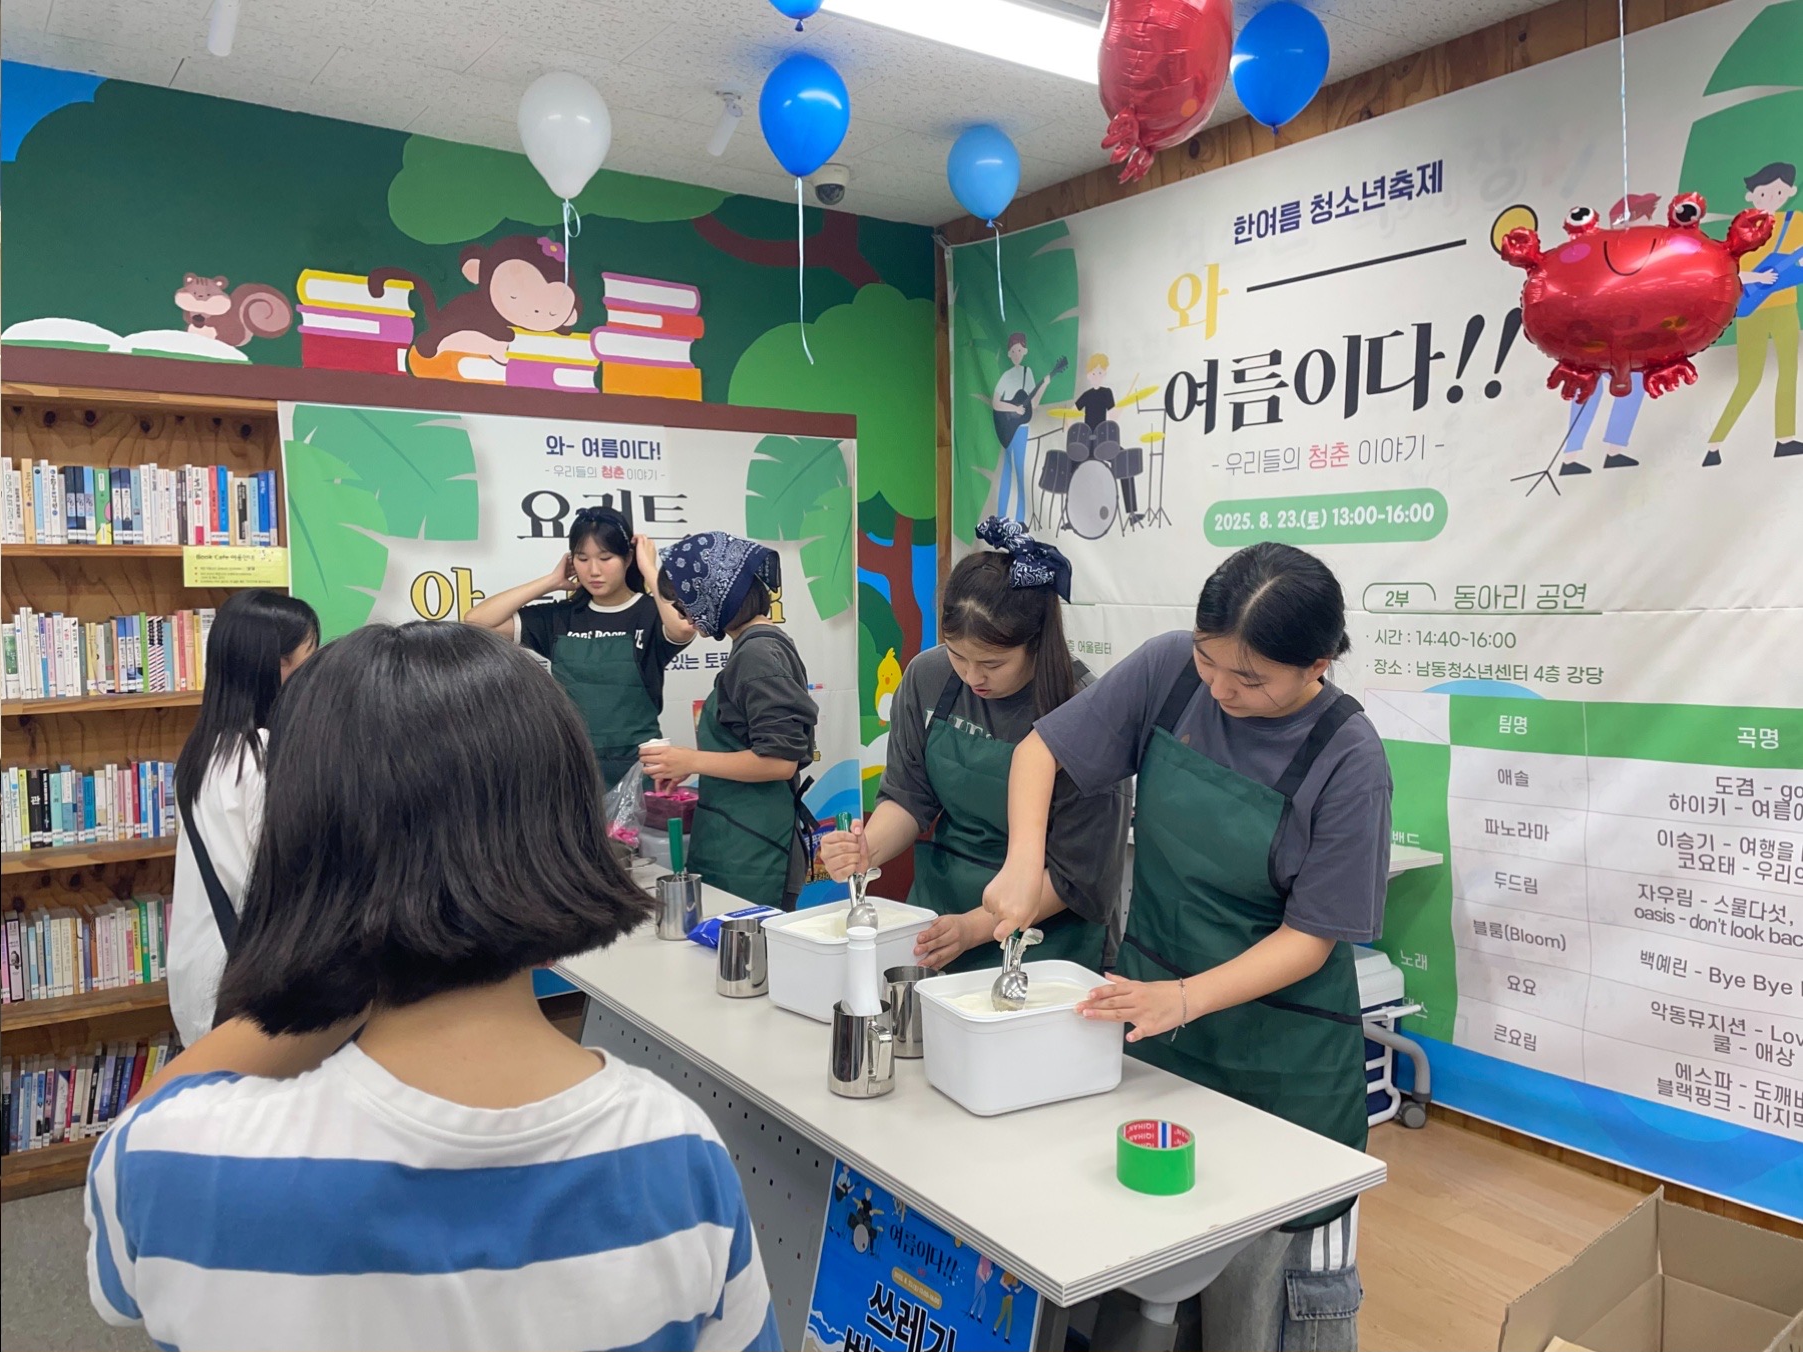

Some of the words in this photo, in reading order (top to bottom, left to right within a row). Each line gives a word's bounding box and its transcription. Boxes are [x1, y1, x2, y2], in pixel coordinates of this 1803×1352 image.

[1233, 200, 1302, 246] 한여름
[1310, 159, 1444, 225] 청소년축제
[1166, 263, 1230, 341] 와
[1164, 306, 1524, 436] 여름이다!!
[582, 436, 662, 461] 여름이다!
[1225, 446, 1301, 476] 우리들의
[1308, 442, 1350, 470] 청춘
[1358, 434, 1426, 465] 이야기
[553, 465, 598, 479] 우리들의
[601, 466, 625, 480] 청춘
[627, 466, 658, 481] 이야기
[1214, 513, 1254, 531] 2025.
[1259, 511, 1273, 530] 8.
[1278, 508, 1328, 530] 23.(토)
[1332, 502, 1435, 526] 13:00-16:00
[1384, 590, 1410, 608] 2부
[1454, 584, 1527, 610] 동아리
[1536, 583, 1588, 610] 공연
[1078, 640, 1112, 655] 어울림터
[1374, 629, 1403, 646] 시간
[1416, 630, 1517, 649] 14:40~16:00
[665, 653, 700, 671] 있는
[1374, 658, 1403, 676] 장소
[1416, 660, 1529, 682] 남동청소년센터
[1533, 665, 1561, 683] 4층
[1567, 666, 1605, 685] 강당
[1499, 715, 1528, 735] 팀명
[1737, 726, 1780, 750] 곡명
[1497, 768, 1530, 788] 애솔
[1715, 776, 1755, 797] 도겸
[1668, 793, 1726, 816] 하이키
[1485, 818, 1550, 842] 파노라마
[1657, 829, 1715, 852] 이승기
[1740, 836, 1794, 862] 여행을
[1678, 851, 1736, 876] 코요태
[1494, 871, 1539, 895] 두드림
[1638, 883, 1693, 908] 자우림
[1713, 895, 1794, 927] 스물다섯,
[1473, 919, 1567, 952] 블룸(Bloom)
[1634, 906, 1676, 925] oasis
[1689, 913, 1728, 936] don't
[1730, 920, 1765, 943] look
[1400, 949, 1428, 971] 노래
[1640, 949, 1688, 979] 백예린
[1709, 966, 1746, 990] Bye
[1753, 974, 1793, 997] Bye
[1507, 974, 1537, 996] 요요
[1651, 1000, 1746, 1037] 악동뮤지션
[1494, 1023, 1537, 1052] 큰요림
[1713, 1034, 1732, 1055] 쿨
[1755, 1042, 1796, 1068] 애상
[1675, 1062, 1733, 1091] 에스파
[1657, 1077, 1732, 1112] 블랙핑크
[889, 1223, 958, 1282] 여름이다!!
